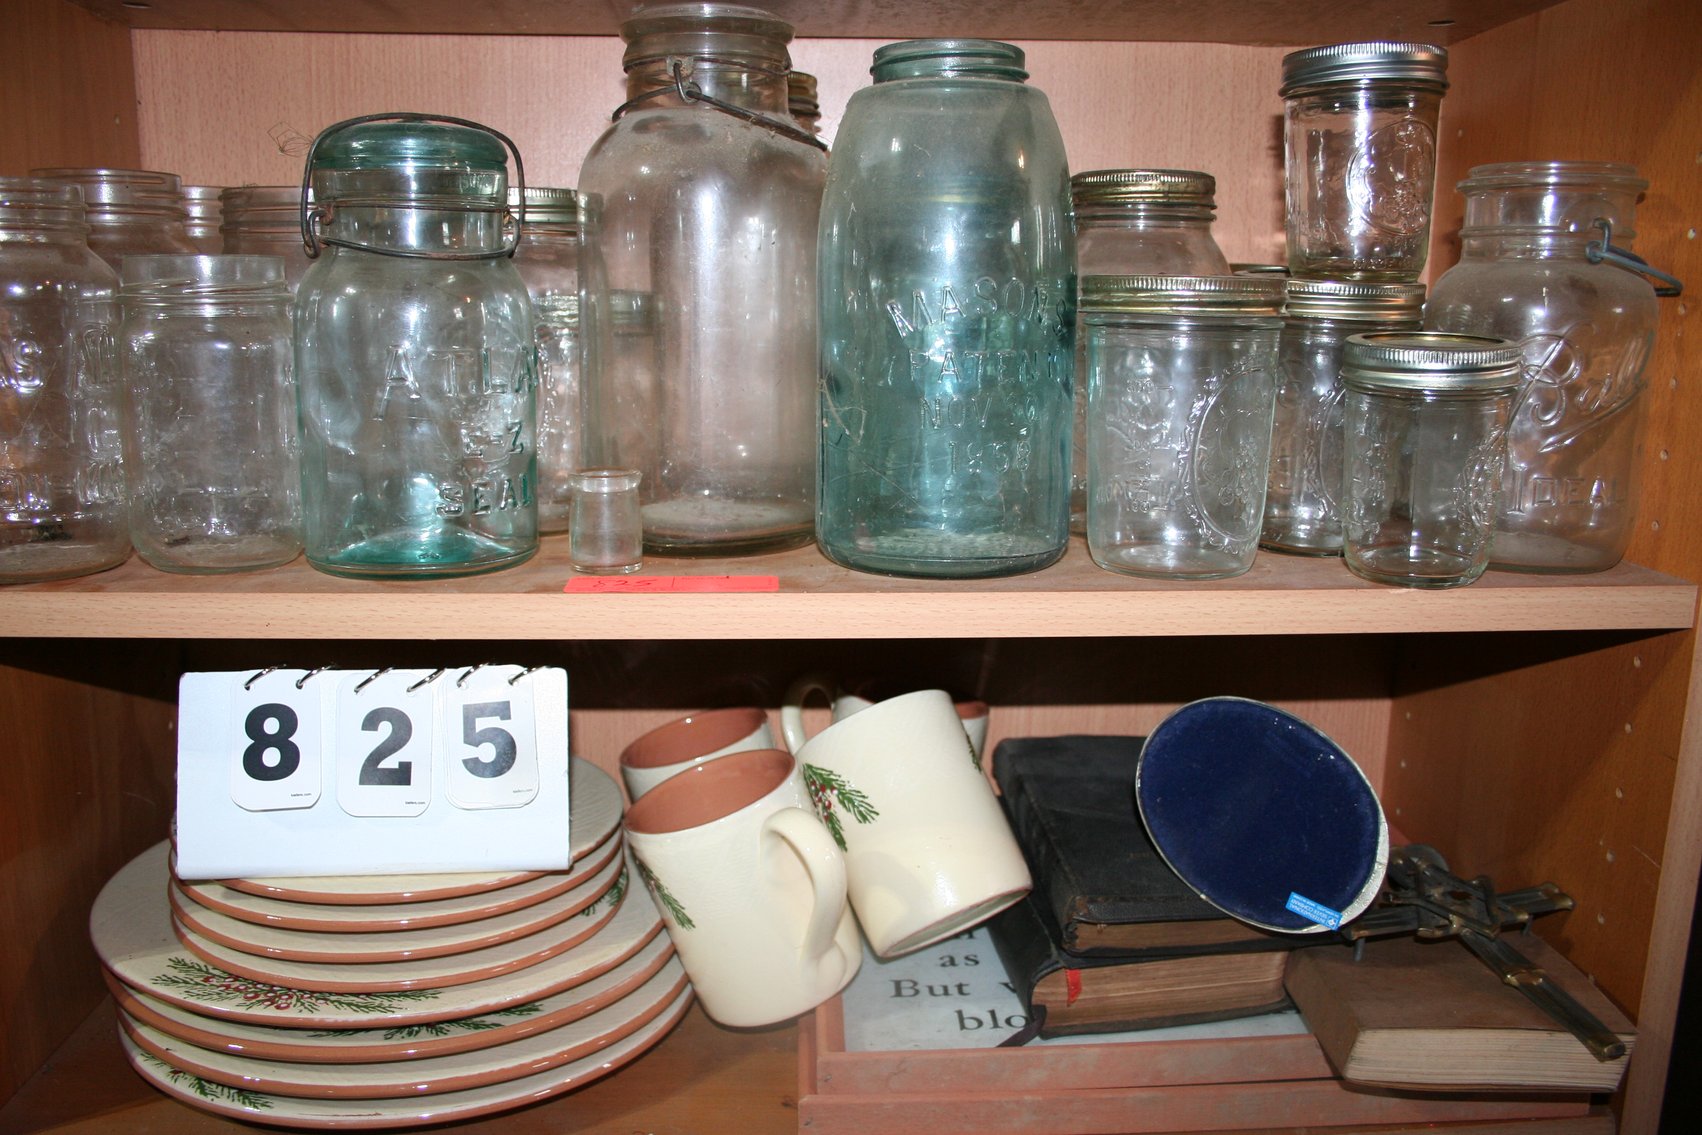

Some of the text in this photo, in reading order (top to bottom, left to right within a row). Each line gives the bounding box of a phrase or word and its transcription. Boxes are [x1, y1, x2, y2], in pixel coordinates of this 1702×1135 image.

[947, 440, 1032, 475] 1858
[435, 473, 531, 518] SEAL
[938, 952, 981, 968] as
[889, 978, 971, 999] But
